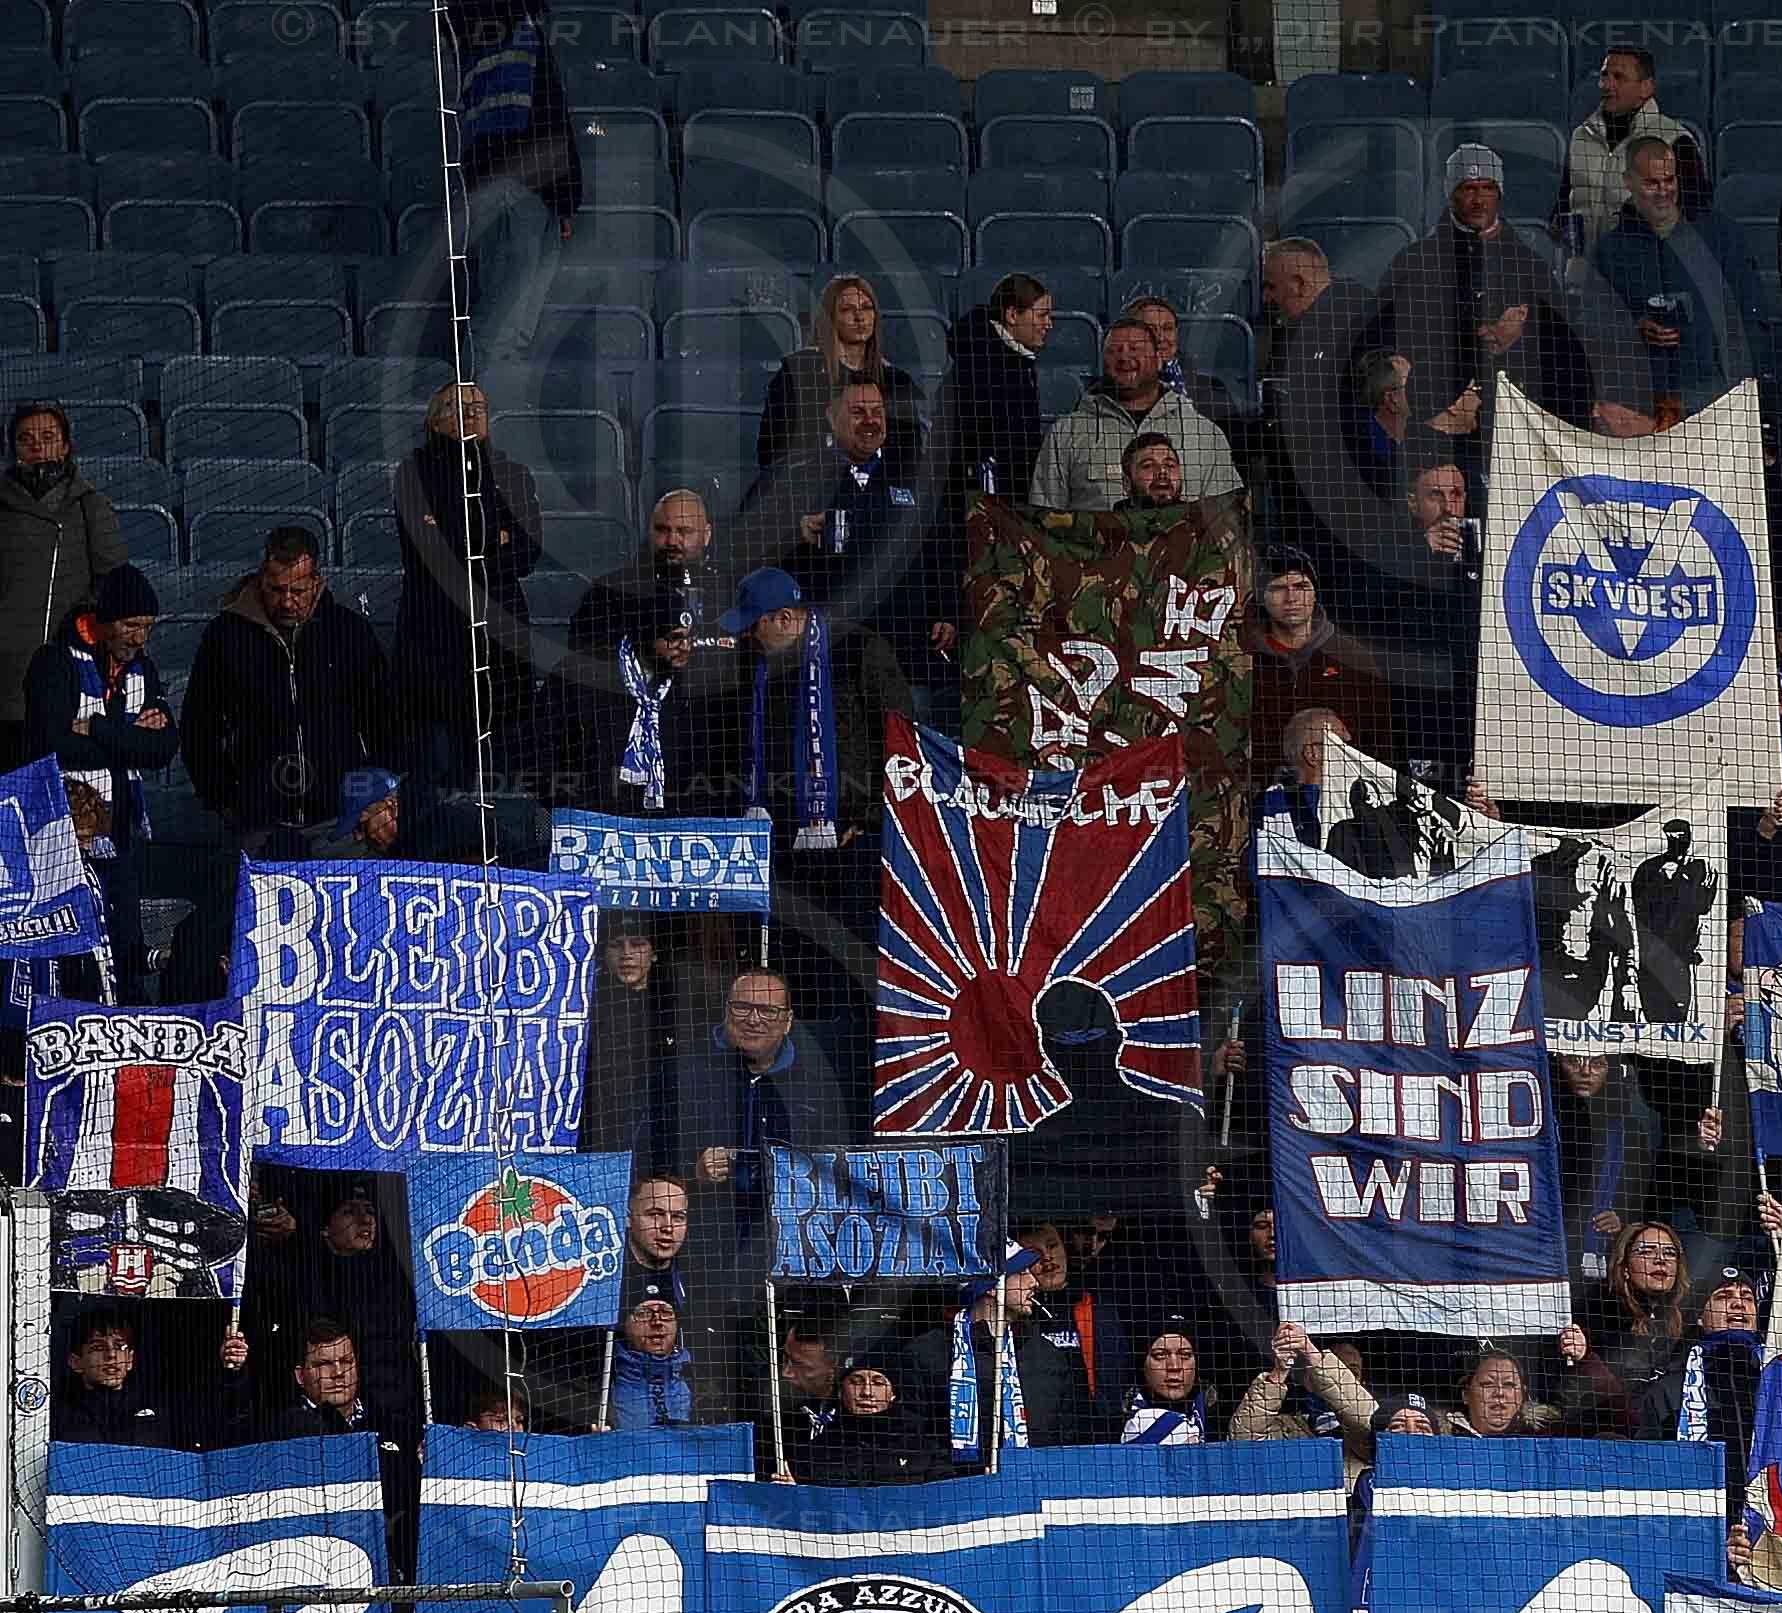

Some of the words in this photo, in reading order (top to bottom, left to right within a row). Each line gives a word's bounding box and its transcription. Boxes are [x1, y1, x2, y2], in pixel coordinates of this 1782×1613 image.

[1547, 573, 1596, 608] SK
[1603, 572, 1713, 620] VÖEST
[555, 826, 766, 882] BANDA
[611, 889, 720, 908] zzurra
[1275, 964, 1535, 1049] LINZ
[1660, 1022, 1706, 1043] NIX
[28, 1015, 249, 1083] BANDA
[247, 1010, 588, 1153] ASOZIAL
[1287, 1065, 1543, 1143] SIND
[770, 1143, 983, 1219] BLEIBT
[1311, 1155, 1530, 1225] WIR
[775, 1212, 983, 1279] ASOZIAL
